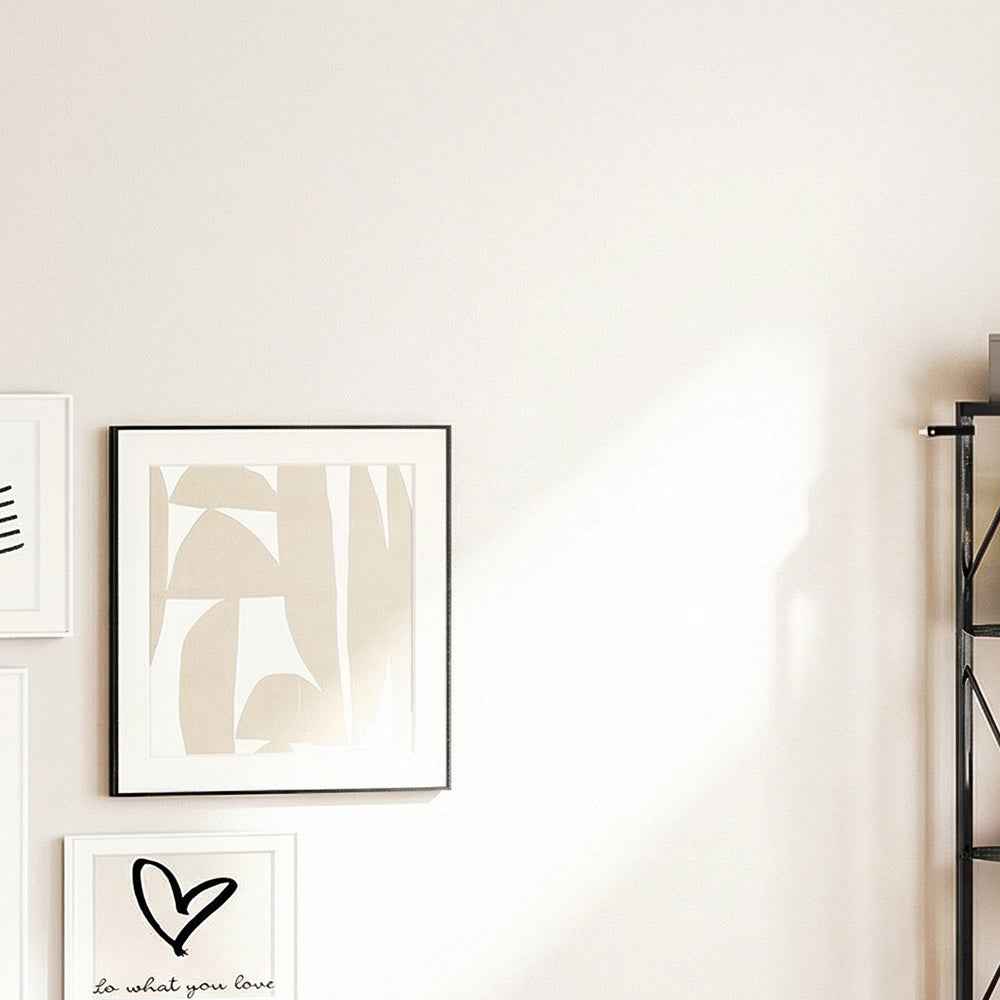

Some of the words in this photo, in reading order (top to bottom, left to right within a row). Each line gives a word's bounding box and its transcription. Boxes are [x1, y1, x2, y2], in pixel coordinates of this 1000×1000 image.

[126, 976, 182, 994] what
[186, 983, 228, 1000] you
[234, 974, 275, 991] love
